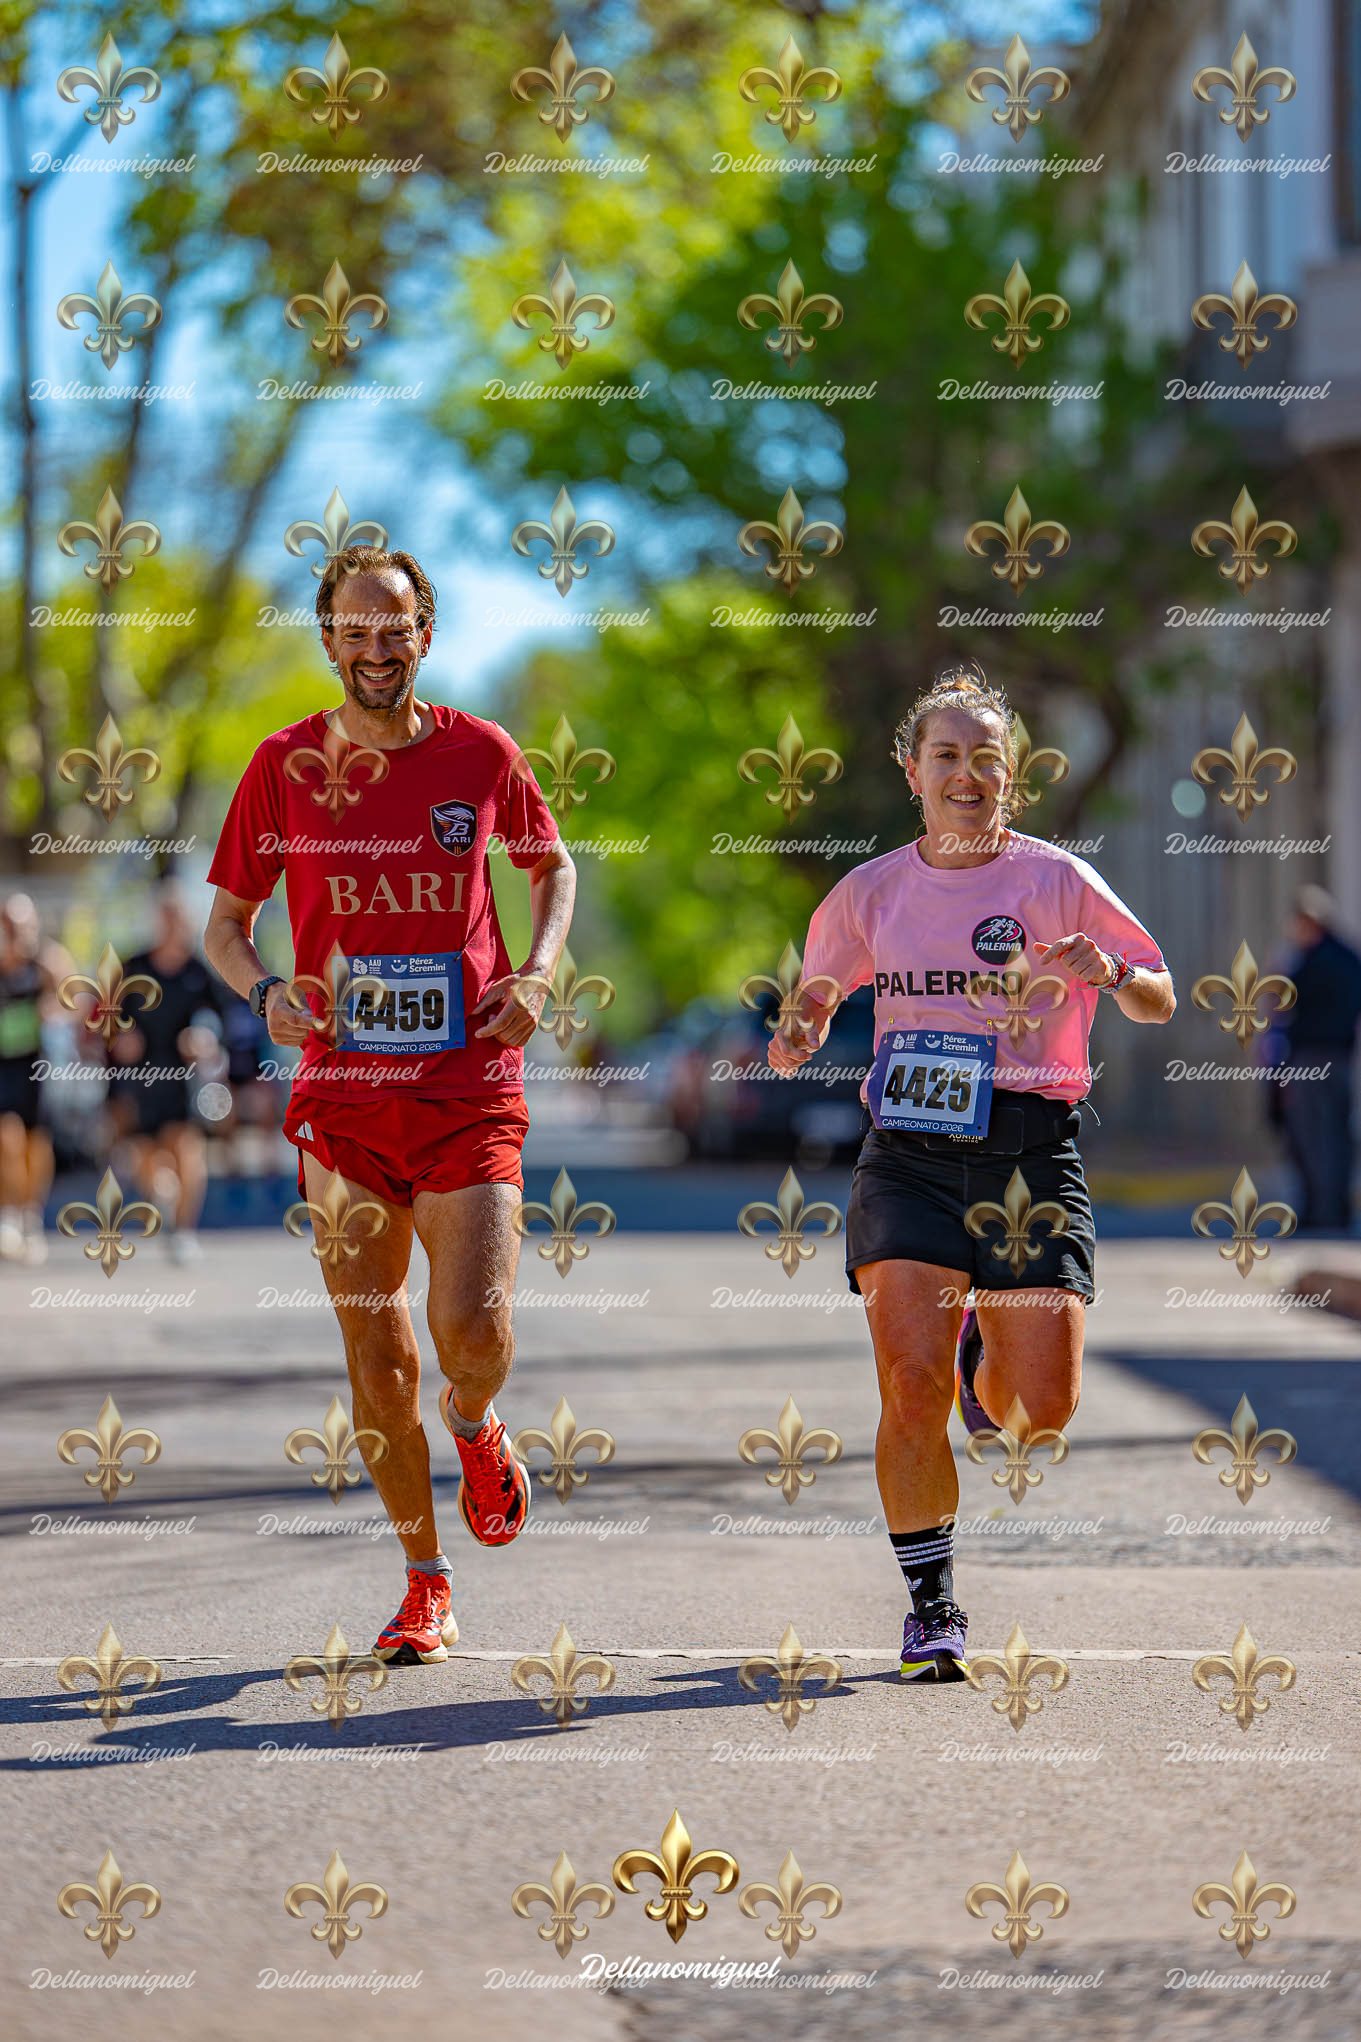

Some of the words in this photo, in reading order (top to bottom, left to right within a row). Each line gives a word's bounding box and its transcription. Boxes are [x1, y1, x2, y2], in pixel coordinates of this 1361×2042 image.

[324, 872, 469, 915] BARI
[976, 942, 1022, 951] PALERMO
[409, 957, 434, 965] Pérez
[409, 963, 446, 973] Scremini
[875, 970, 1023, 997] PALERMO
[355, 988, 445, 1032] 4459
[943, 1034, 967, 1043] Pérez
[358, 1043, 417, 1052] CAMPEONATO
[418, 1042, 442, 1051] 2026
[942, 1042, 979, 1052] Scremini
[884, 1064, 972, 1113] 4425
[882, 1118, 940, 1130] CAMPEONATO
[940, 1123, 964, 1132] 2026
